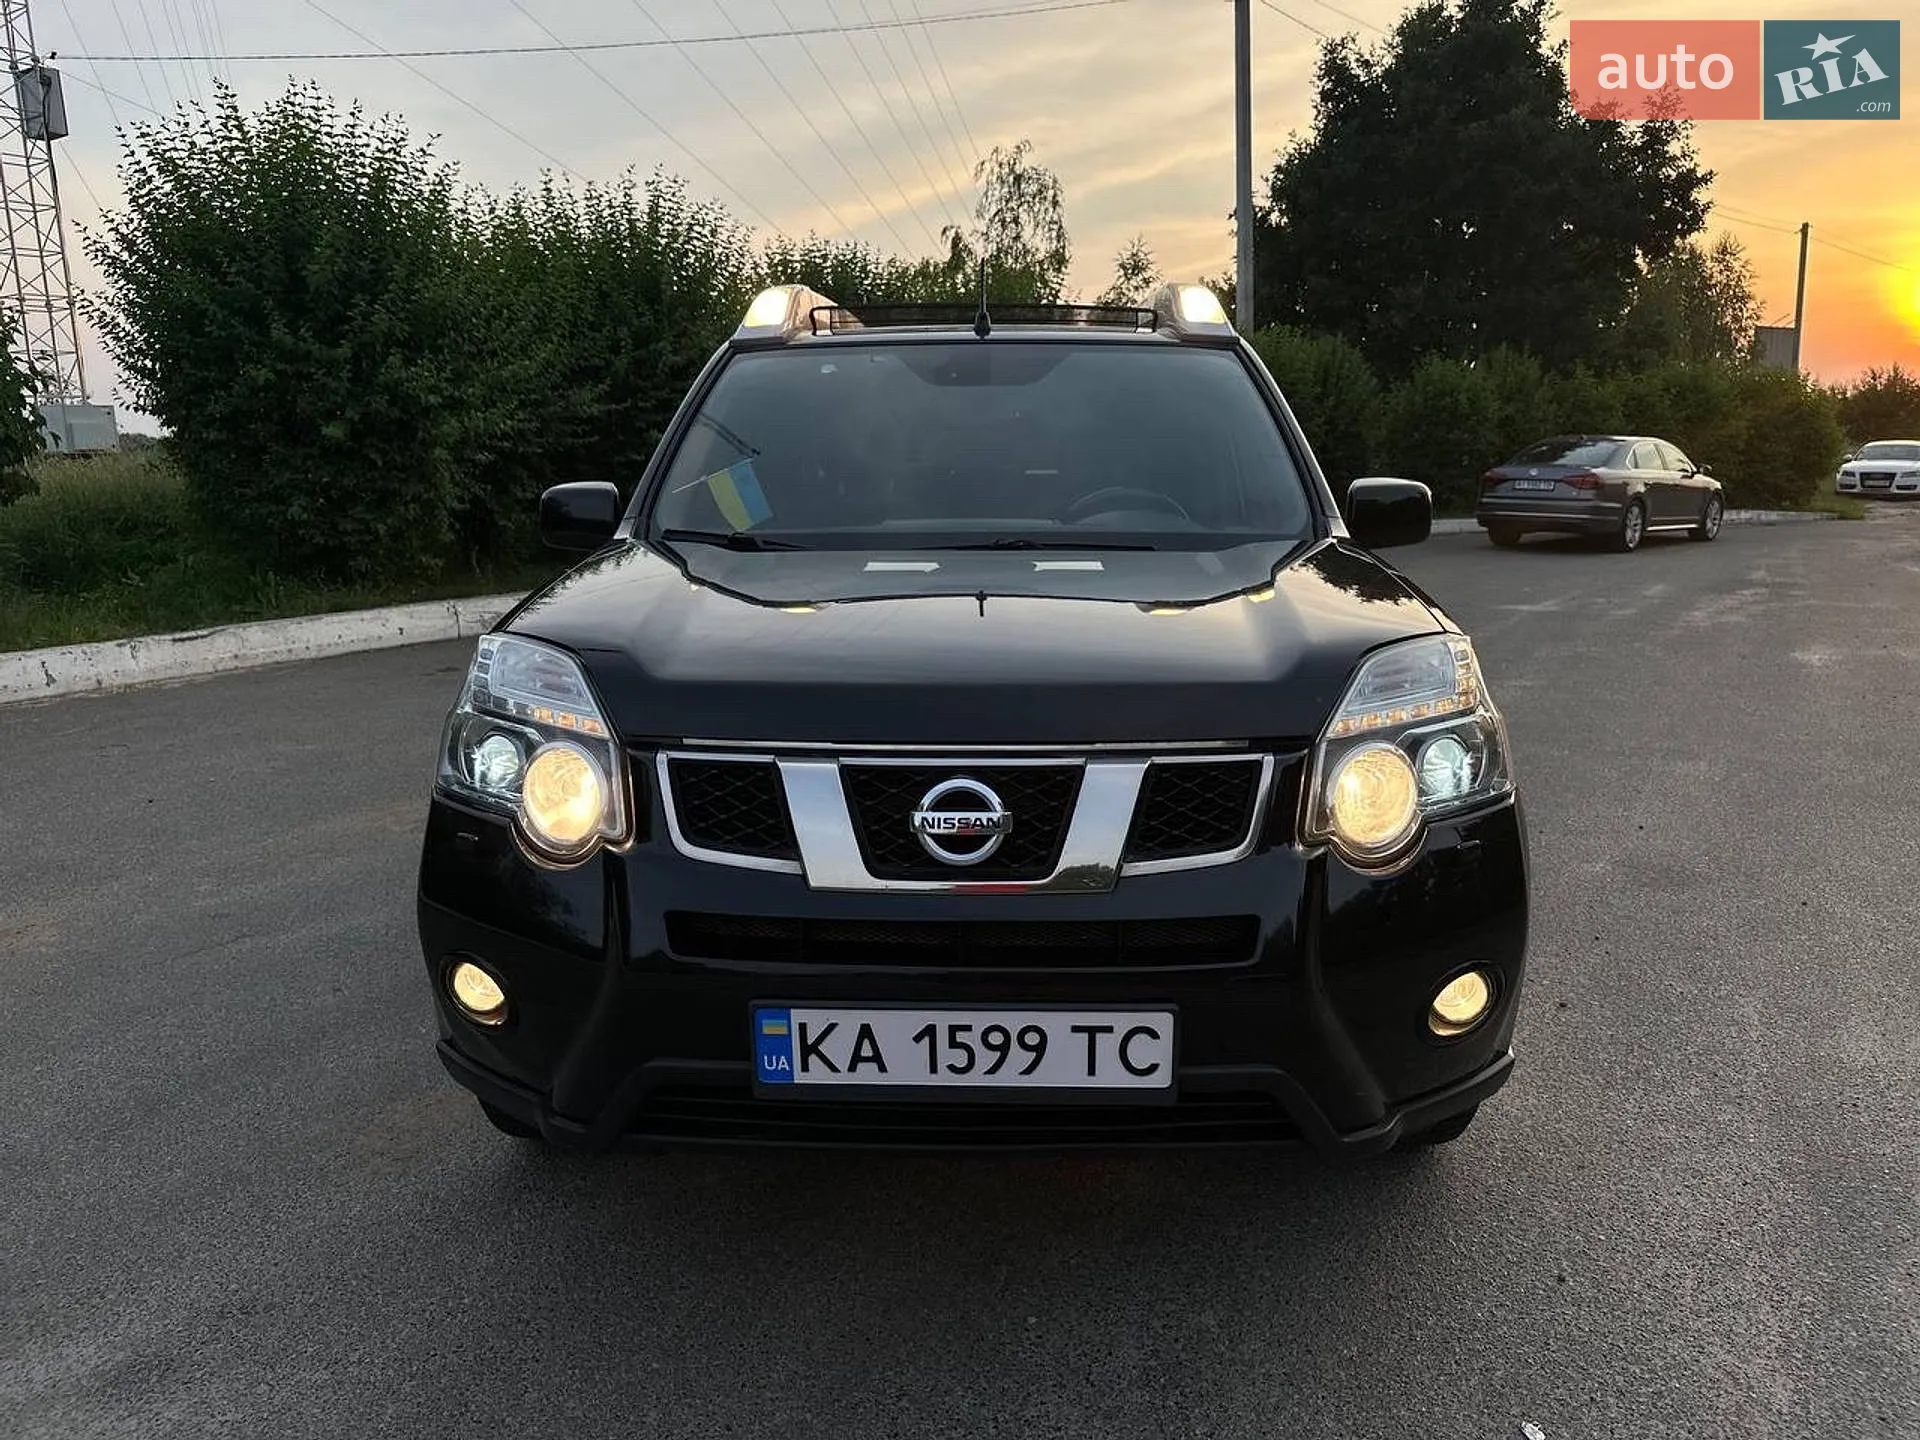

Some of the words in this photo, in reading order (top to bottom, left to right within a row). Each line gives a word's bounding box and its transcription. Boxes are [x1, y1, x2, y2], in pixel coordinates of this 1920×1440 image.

[920, 816, 1001, 830] NISSAN
[798, 1022, 888, 1074] KA
[911, 1023, 1048, 1076] 1599
[1071, 1025, 1161, 1077] TC
[763, 1055, 790, 1072] UA
